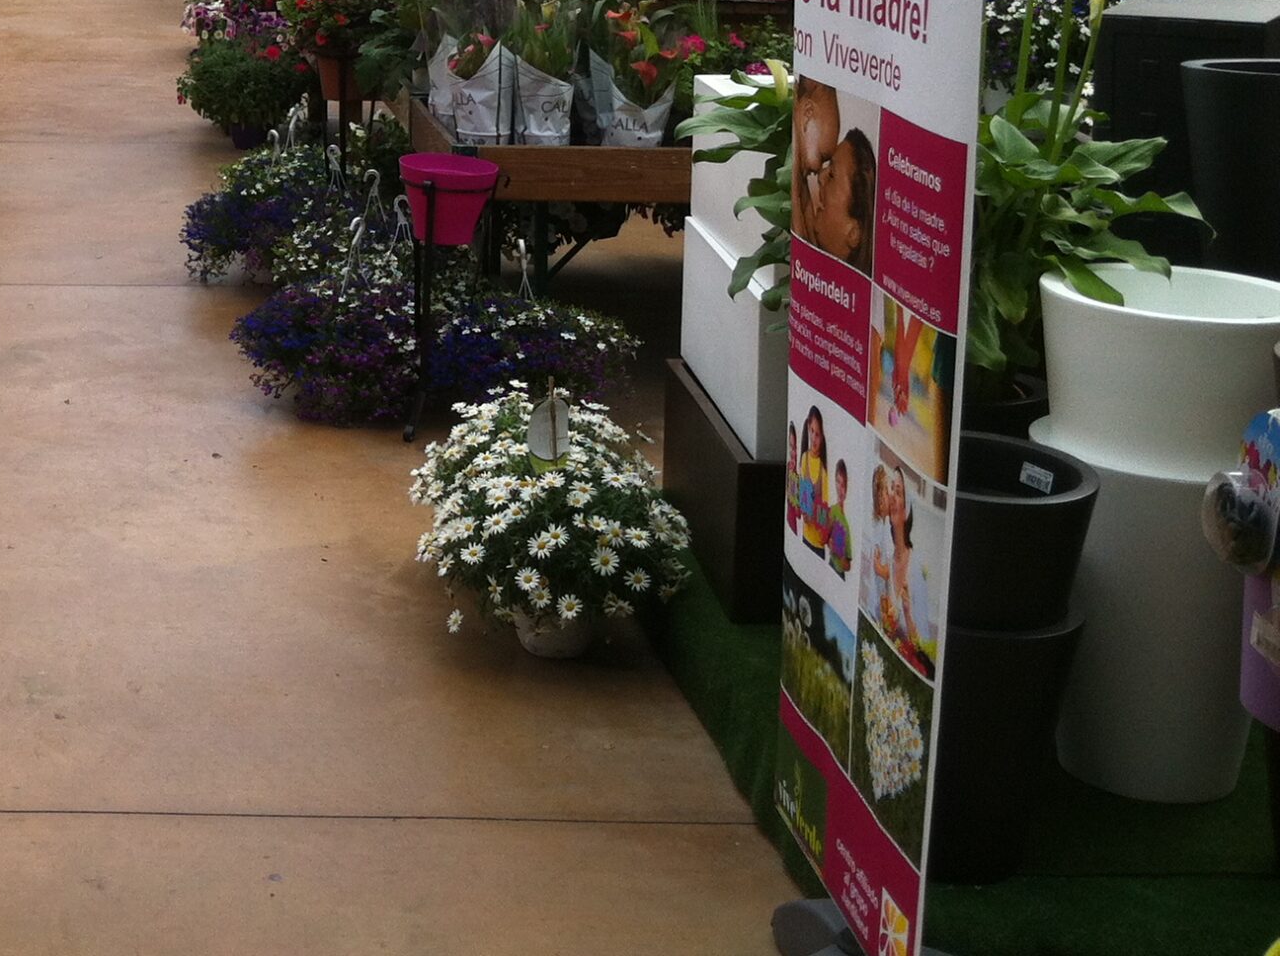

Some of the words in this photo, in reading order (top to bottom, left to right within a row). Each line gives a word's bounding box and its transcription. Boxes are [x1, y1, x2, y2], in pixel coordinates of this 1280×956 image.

[823, 30, 902, 92] Viveverde
[612, 117, 649, 134] ALLA
[888, 147, 942, 193] Celebramos
[901, 197, 911, 213] de
